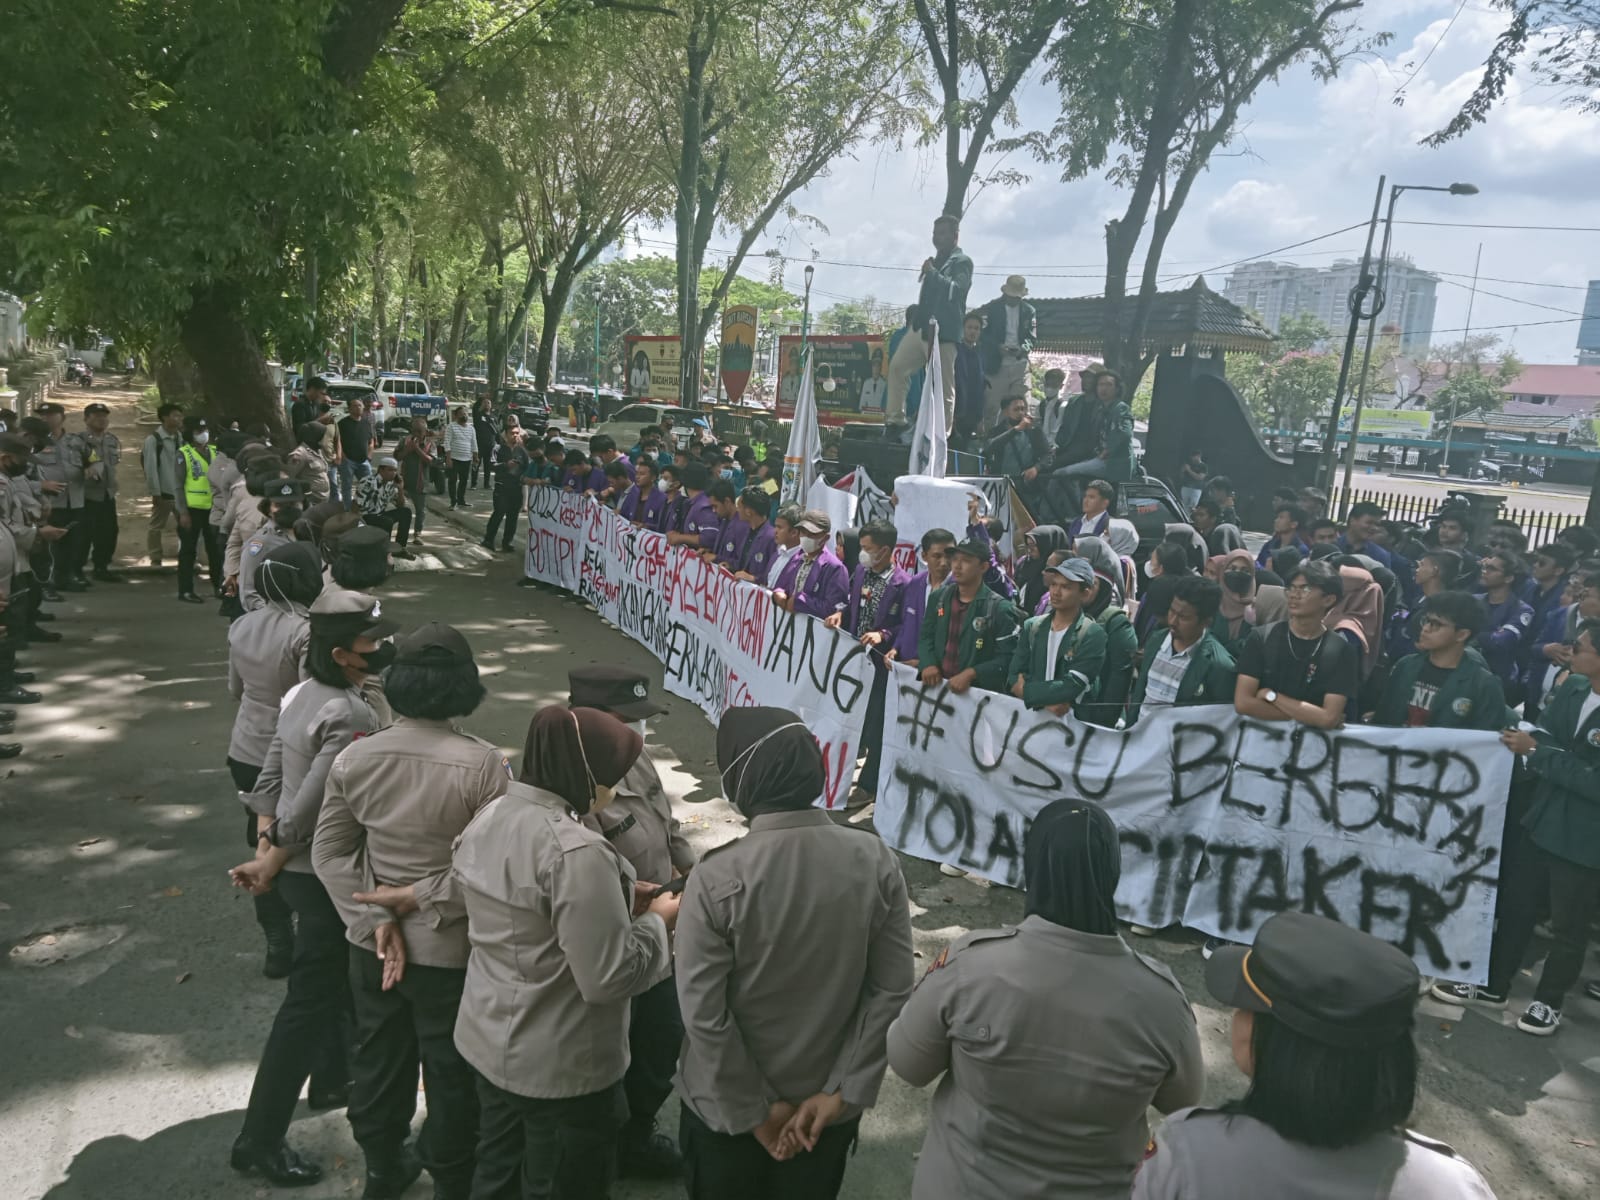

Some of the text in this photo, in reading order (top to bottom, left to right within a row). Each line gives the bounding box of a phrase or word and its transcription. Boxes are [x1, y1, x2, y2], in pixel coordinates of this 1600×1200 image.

[410, 401, 432, 409] POLISI
[764, 600, 866, 714] YANG
[896, 682, 1129, 800] #USU
[894, 760, 1028, 887] TOLA
